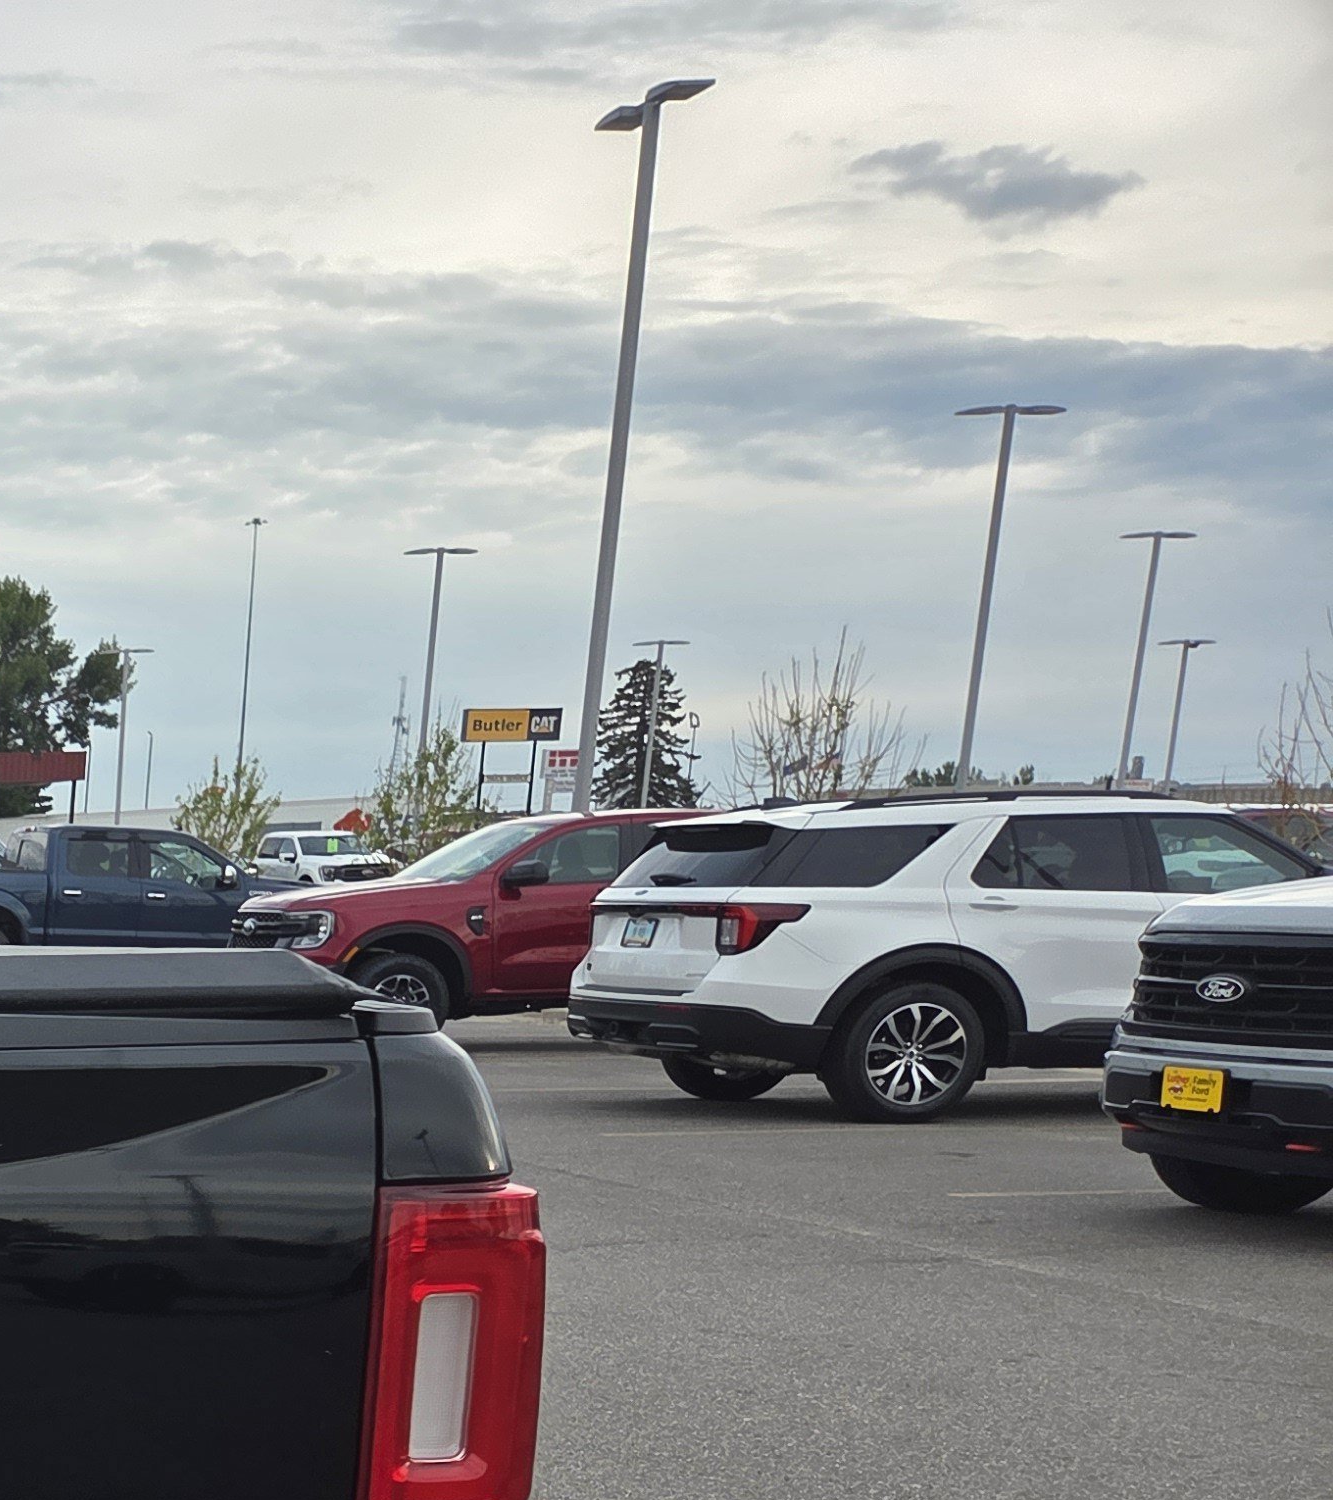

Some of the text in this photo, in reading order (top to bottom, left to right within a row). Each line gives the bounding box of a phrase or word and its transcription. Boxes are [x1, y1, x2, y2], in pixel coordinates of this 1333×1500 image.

[472, 718, 523, 732] Butler
[531, 715, 558, 733] CAT
[1204, 980, 1236, 998] Ford
